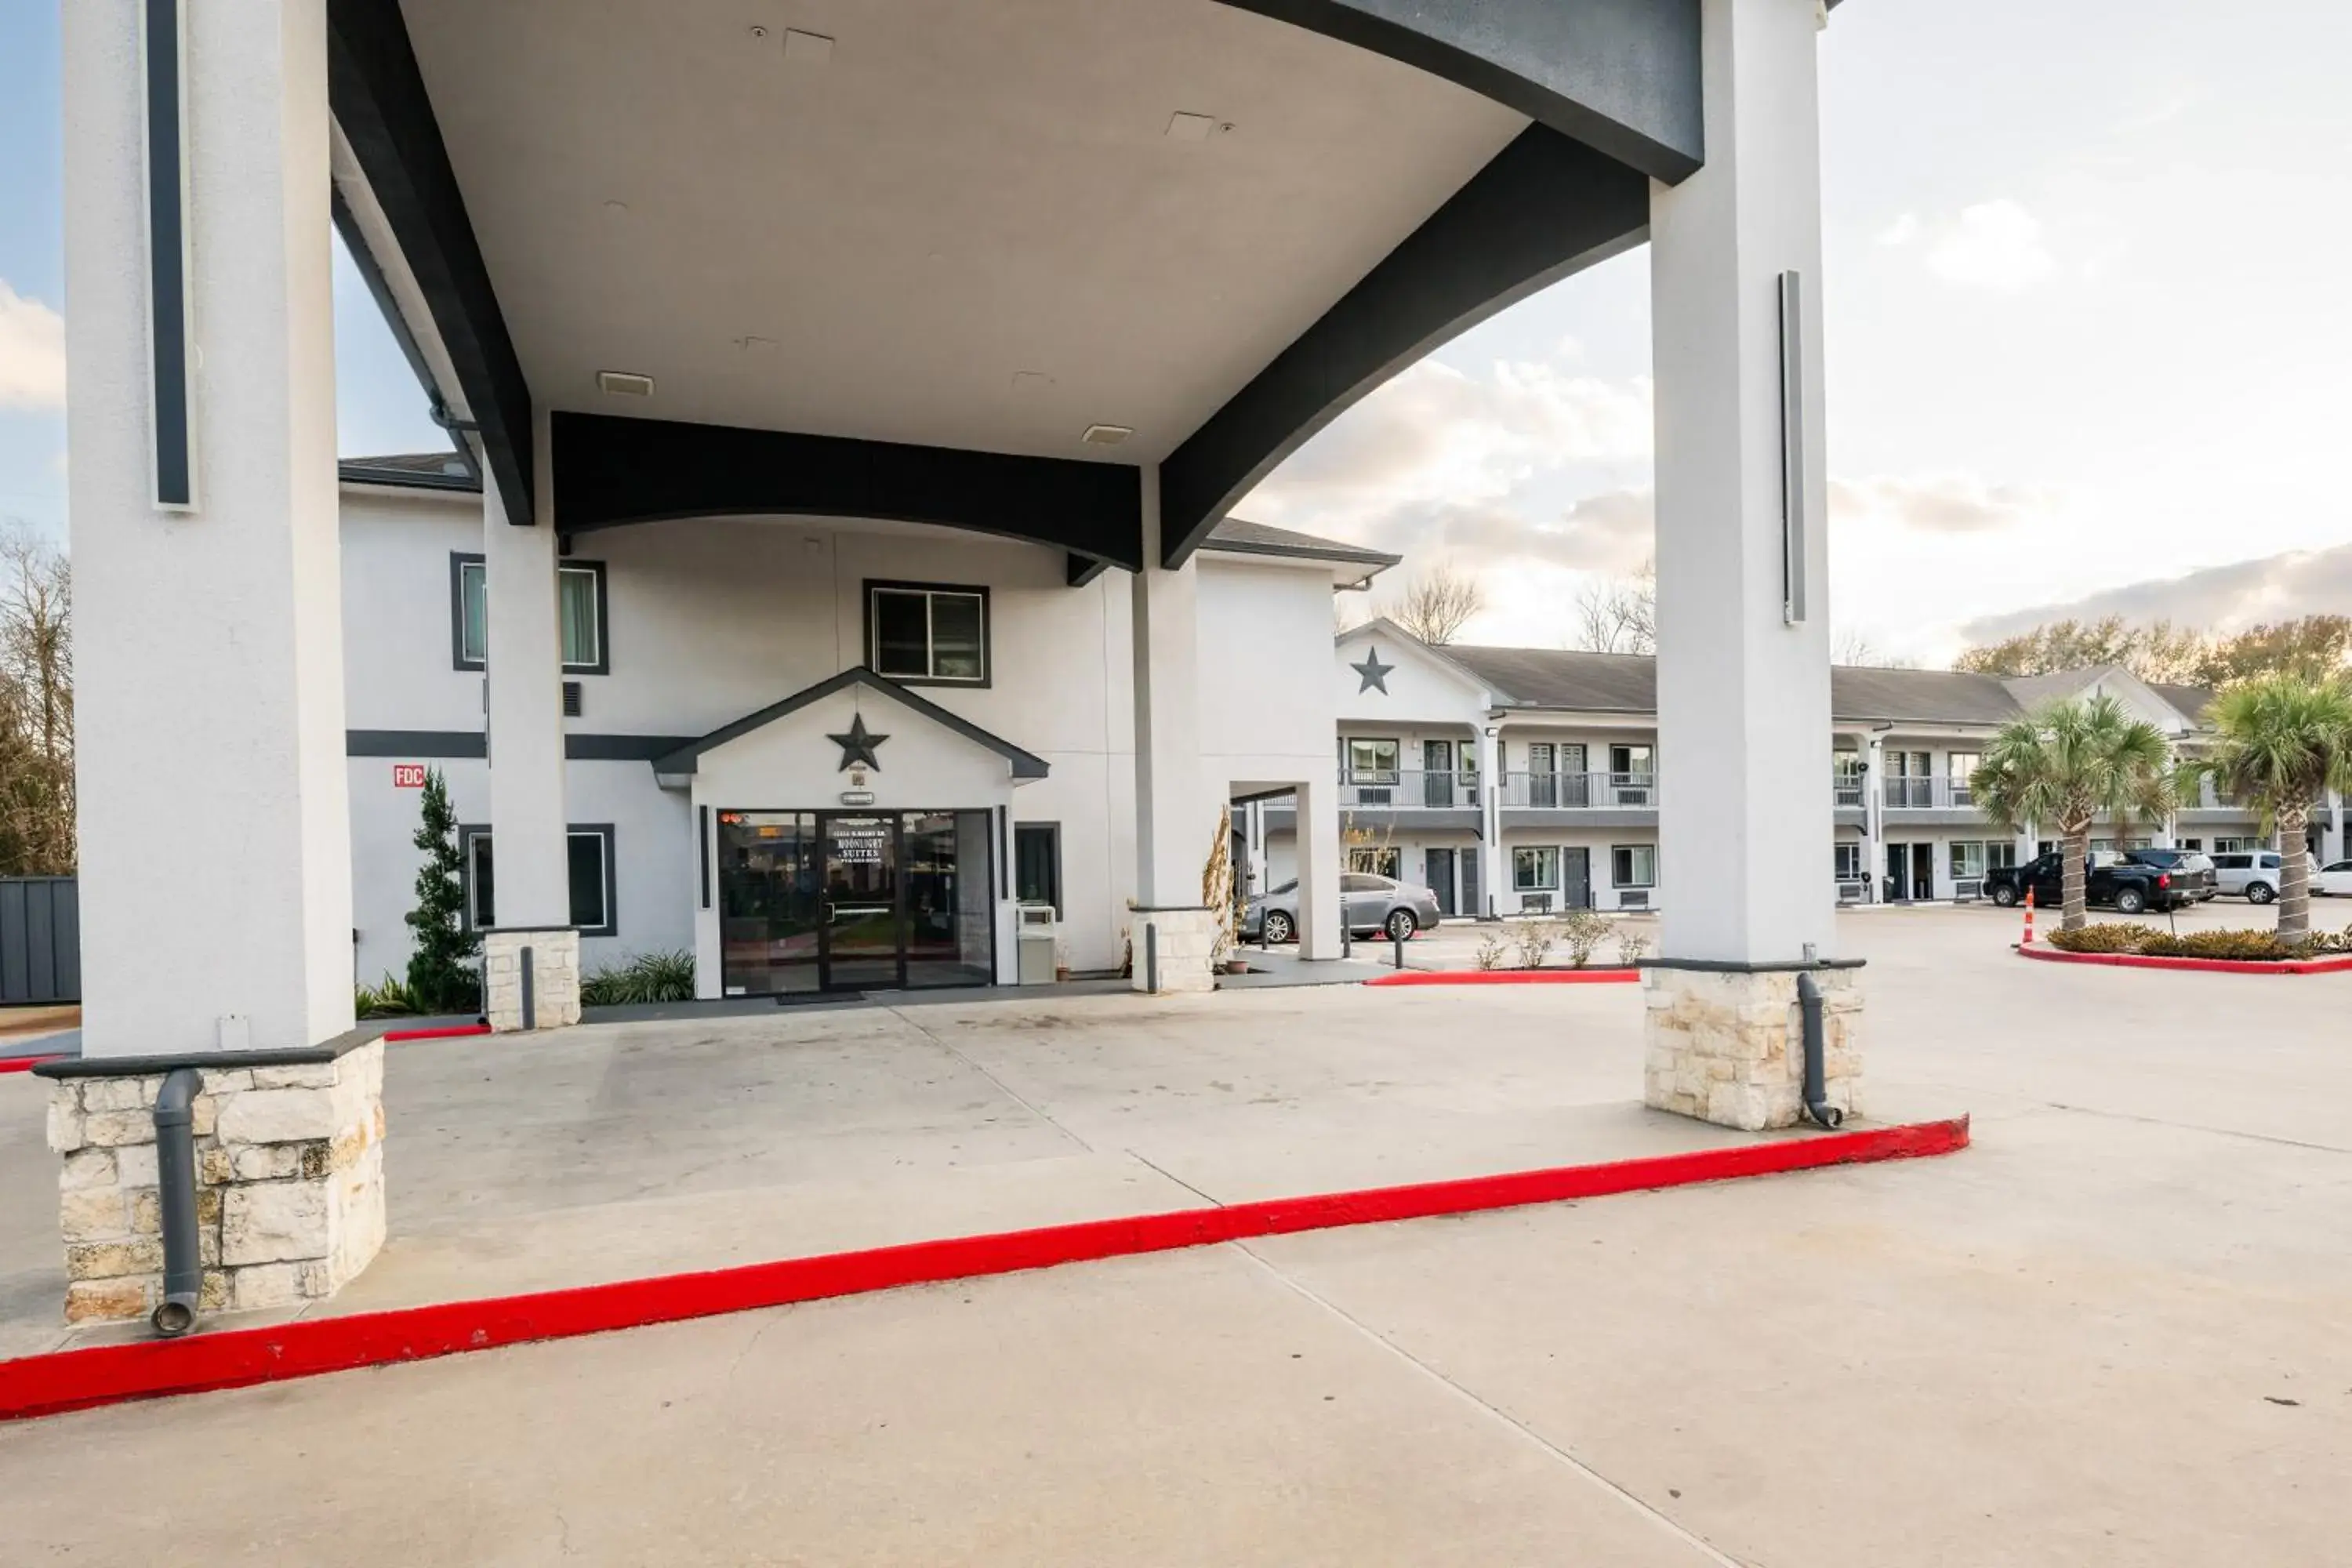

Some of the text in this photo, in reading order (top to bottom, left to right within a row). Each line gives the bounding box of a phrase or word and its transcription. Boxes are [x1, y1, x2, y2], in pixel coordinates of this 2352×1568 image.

[396, 768, 423, 784] FDC
[838, 839, 883, 848] MOONLIGHT
[843, 849, 879, 858] SUITES
